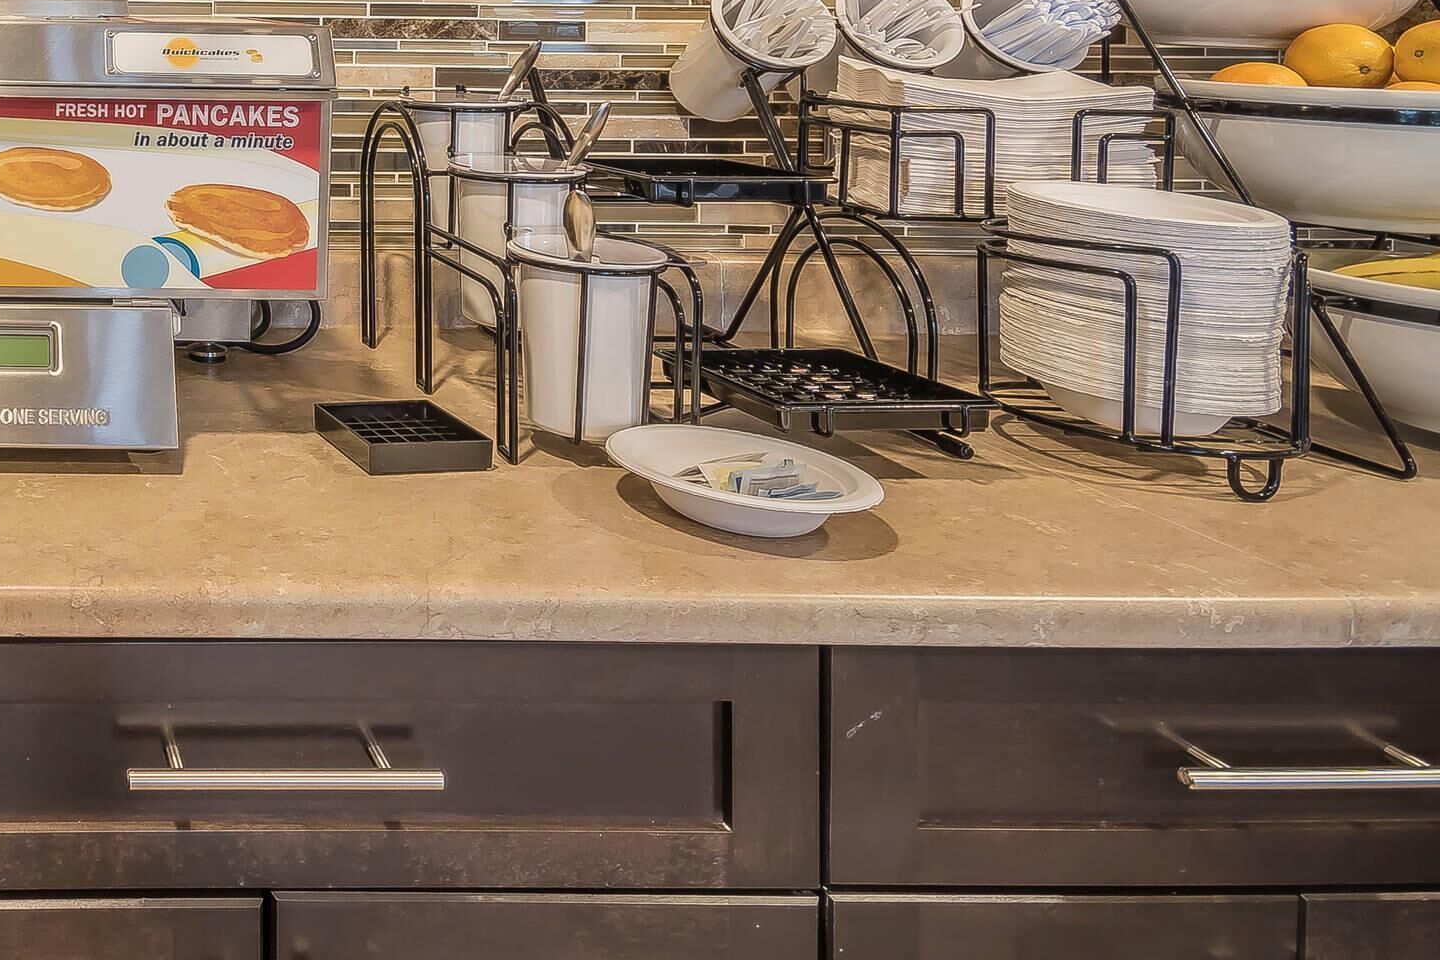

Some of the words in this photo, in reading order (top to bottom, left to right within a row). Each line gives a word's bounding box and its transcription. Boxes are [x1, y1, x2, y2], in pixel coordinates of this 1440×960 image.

[55, 103, 109, 118] FRESH
[114, 104, 147, 118] HOT
[156, 104, 301, 128] PANCAKES
[134, 131, 150, 147] in
[156, 132, 209, 148] about
[214, 137, 225, 149] a
[230, 133, 294, 150] minute
[0, 407, 36, 426] ONE
[38, 407, 110, 427] SERVING
